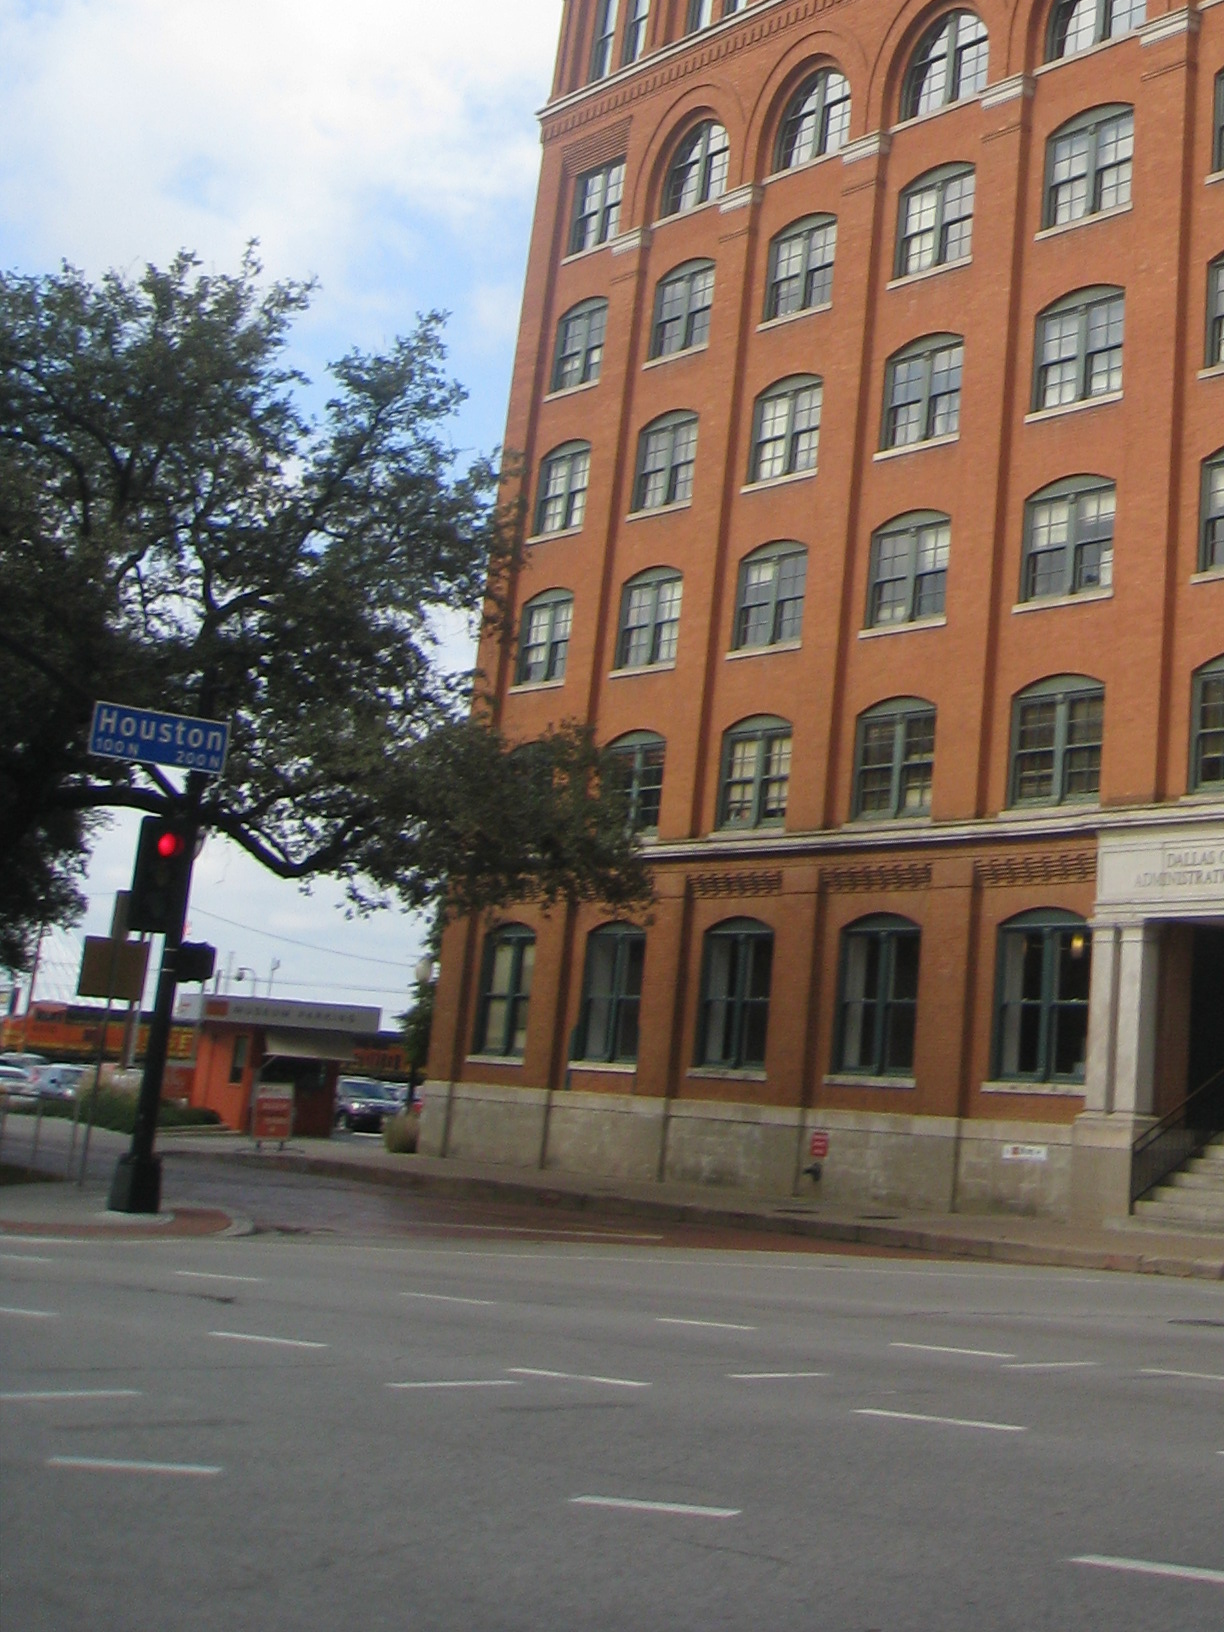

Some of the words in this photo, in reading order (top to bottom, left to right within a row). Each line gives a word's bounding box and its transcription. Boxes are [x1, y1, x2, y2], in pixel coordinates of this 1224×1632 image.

[99, 708, 223, 751] Houston
[96, 735, 125, 754] 100
[128, 742, 140, 757] N
[175, 750, 207, 766] 200
[208, 756, 221, 769] N
[1167, 851, 1215, 868] DALLAS
